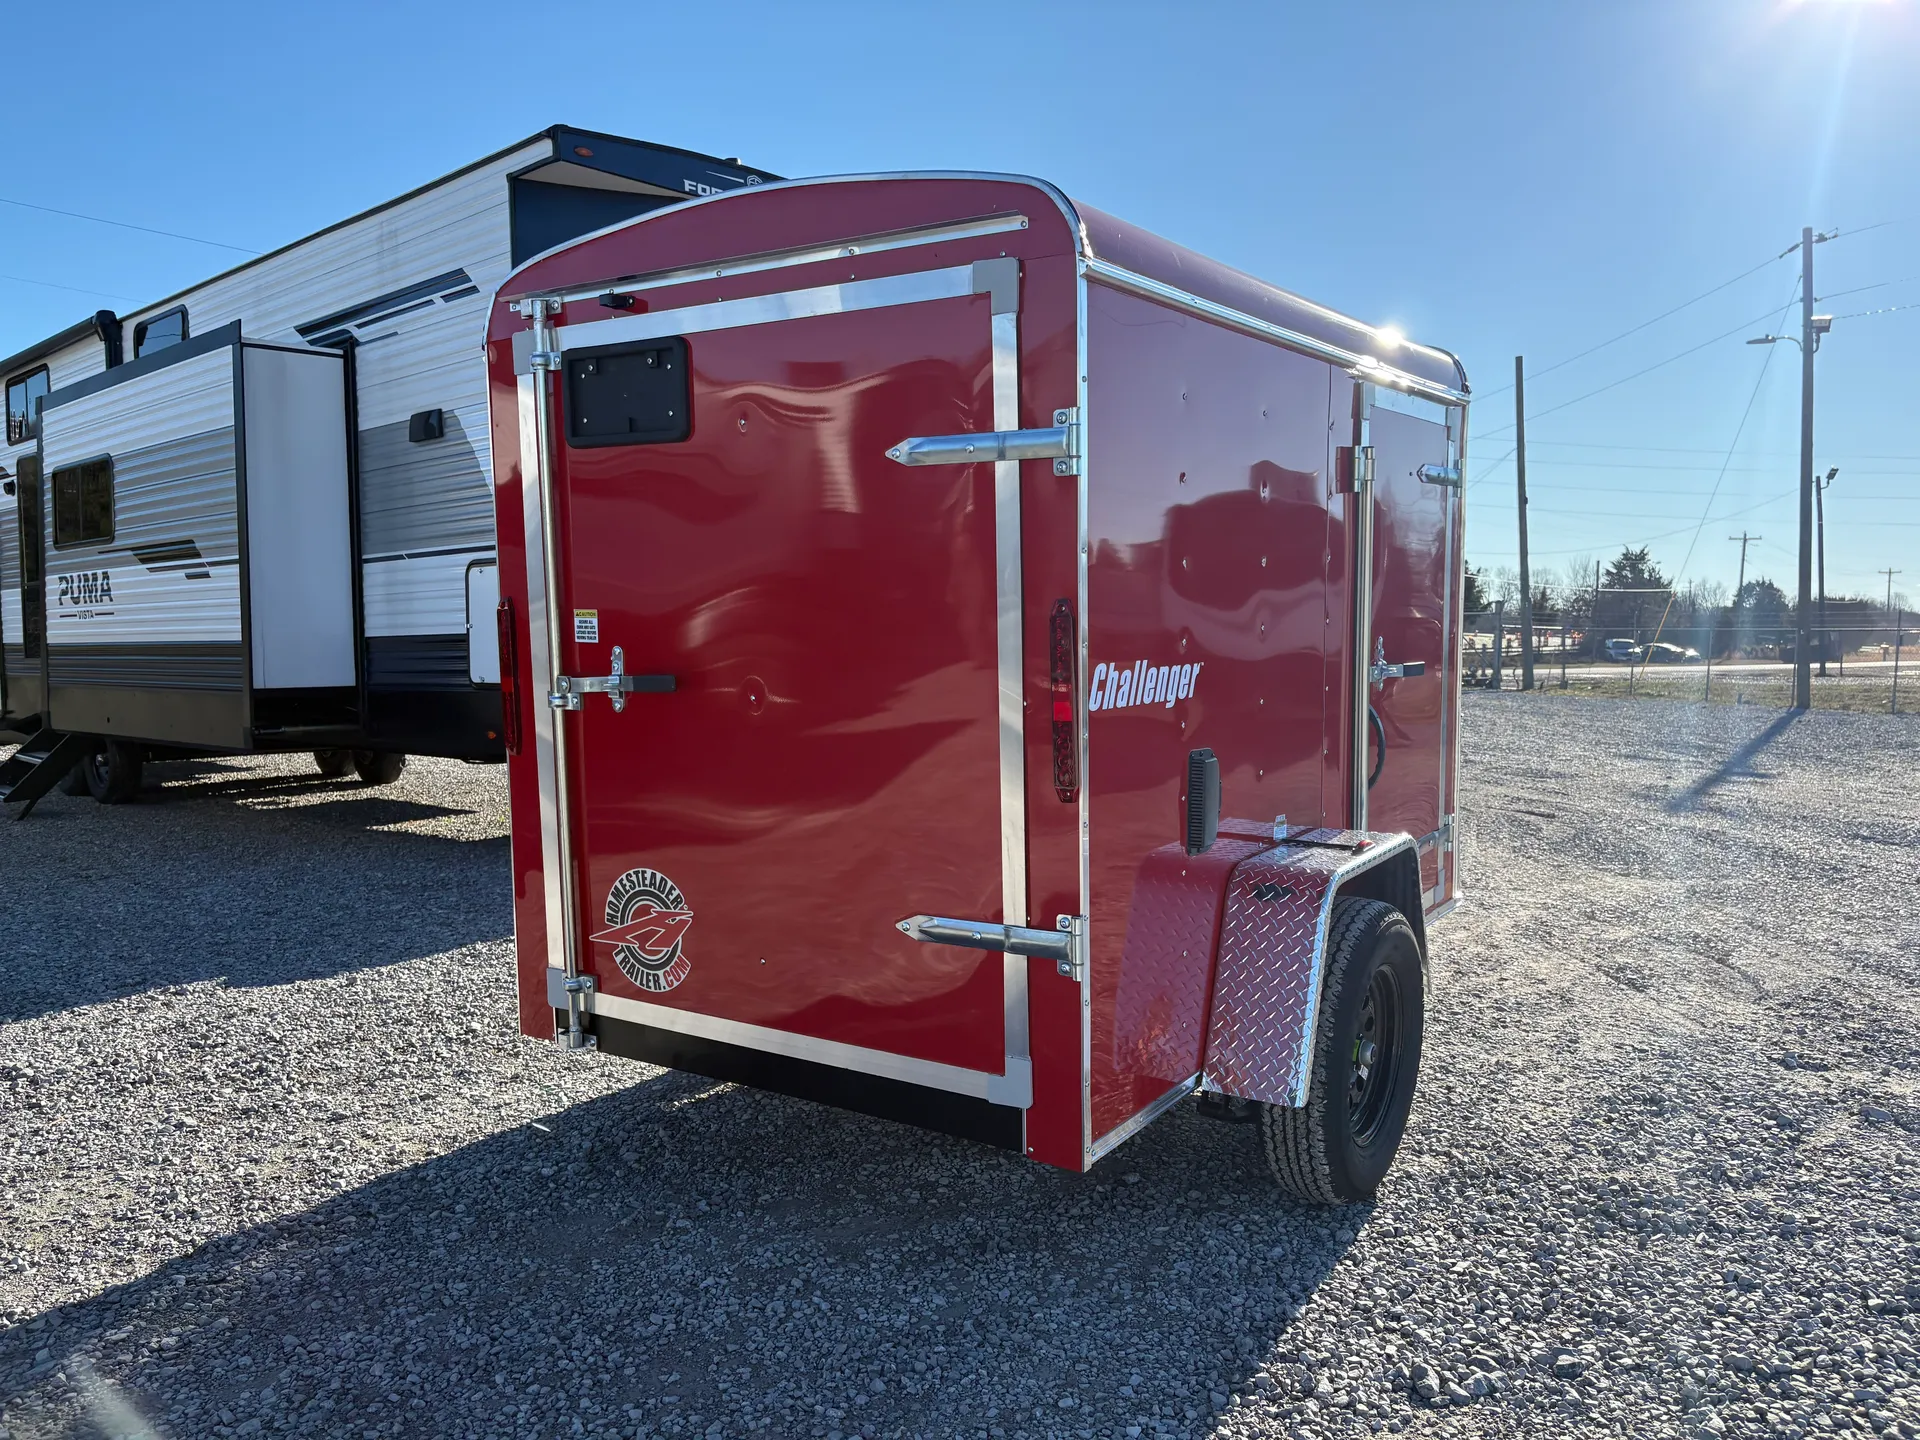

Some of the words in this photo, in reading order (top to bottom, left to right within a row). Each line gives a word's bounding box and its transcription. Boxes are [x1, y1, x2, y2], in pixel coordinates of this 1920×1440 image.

[58, 571, 114, 606] PUMA
[77, 610, 95, 620] VISTA
[1088, 659, 1201, 712] Challenger
[606, 869, 684, 926] HOMESTEADER
